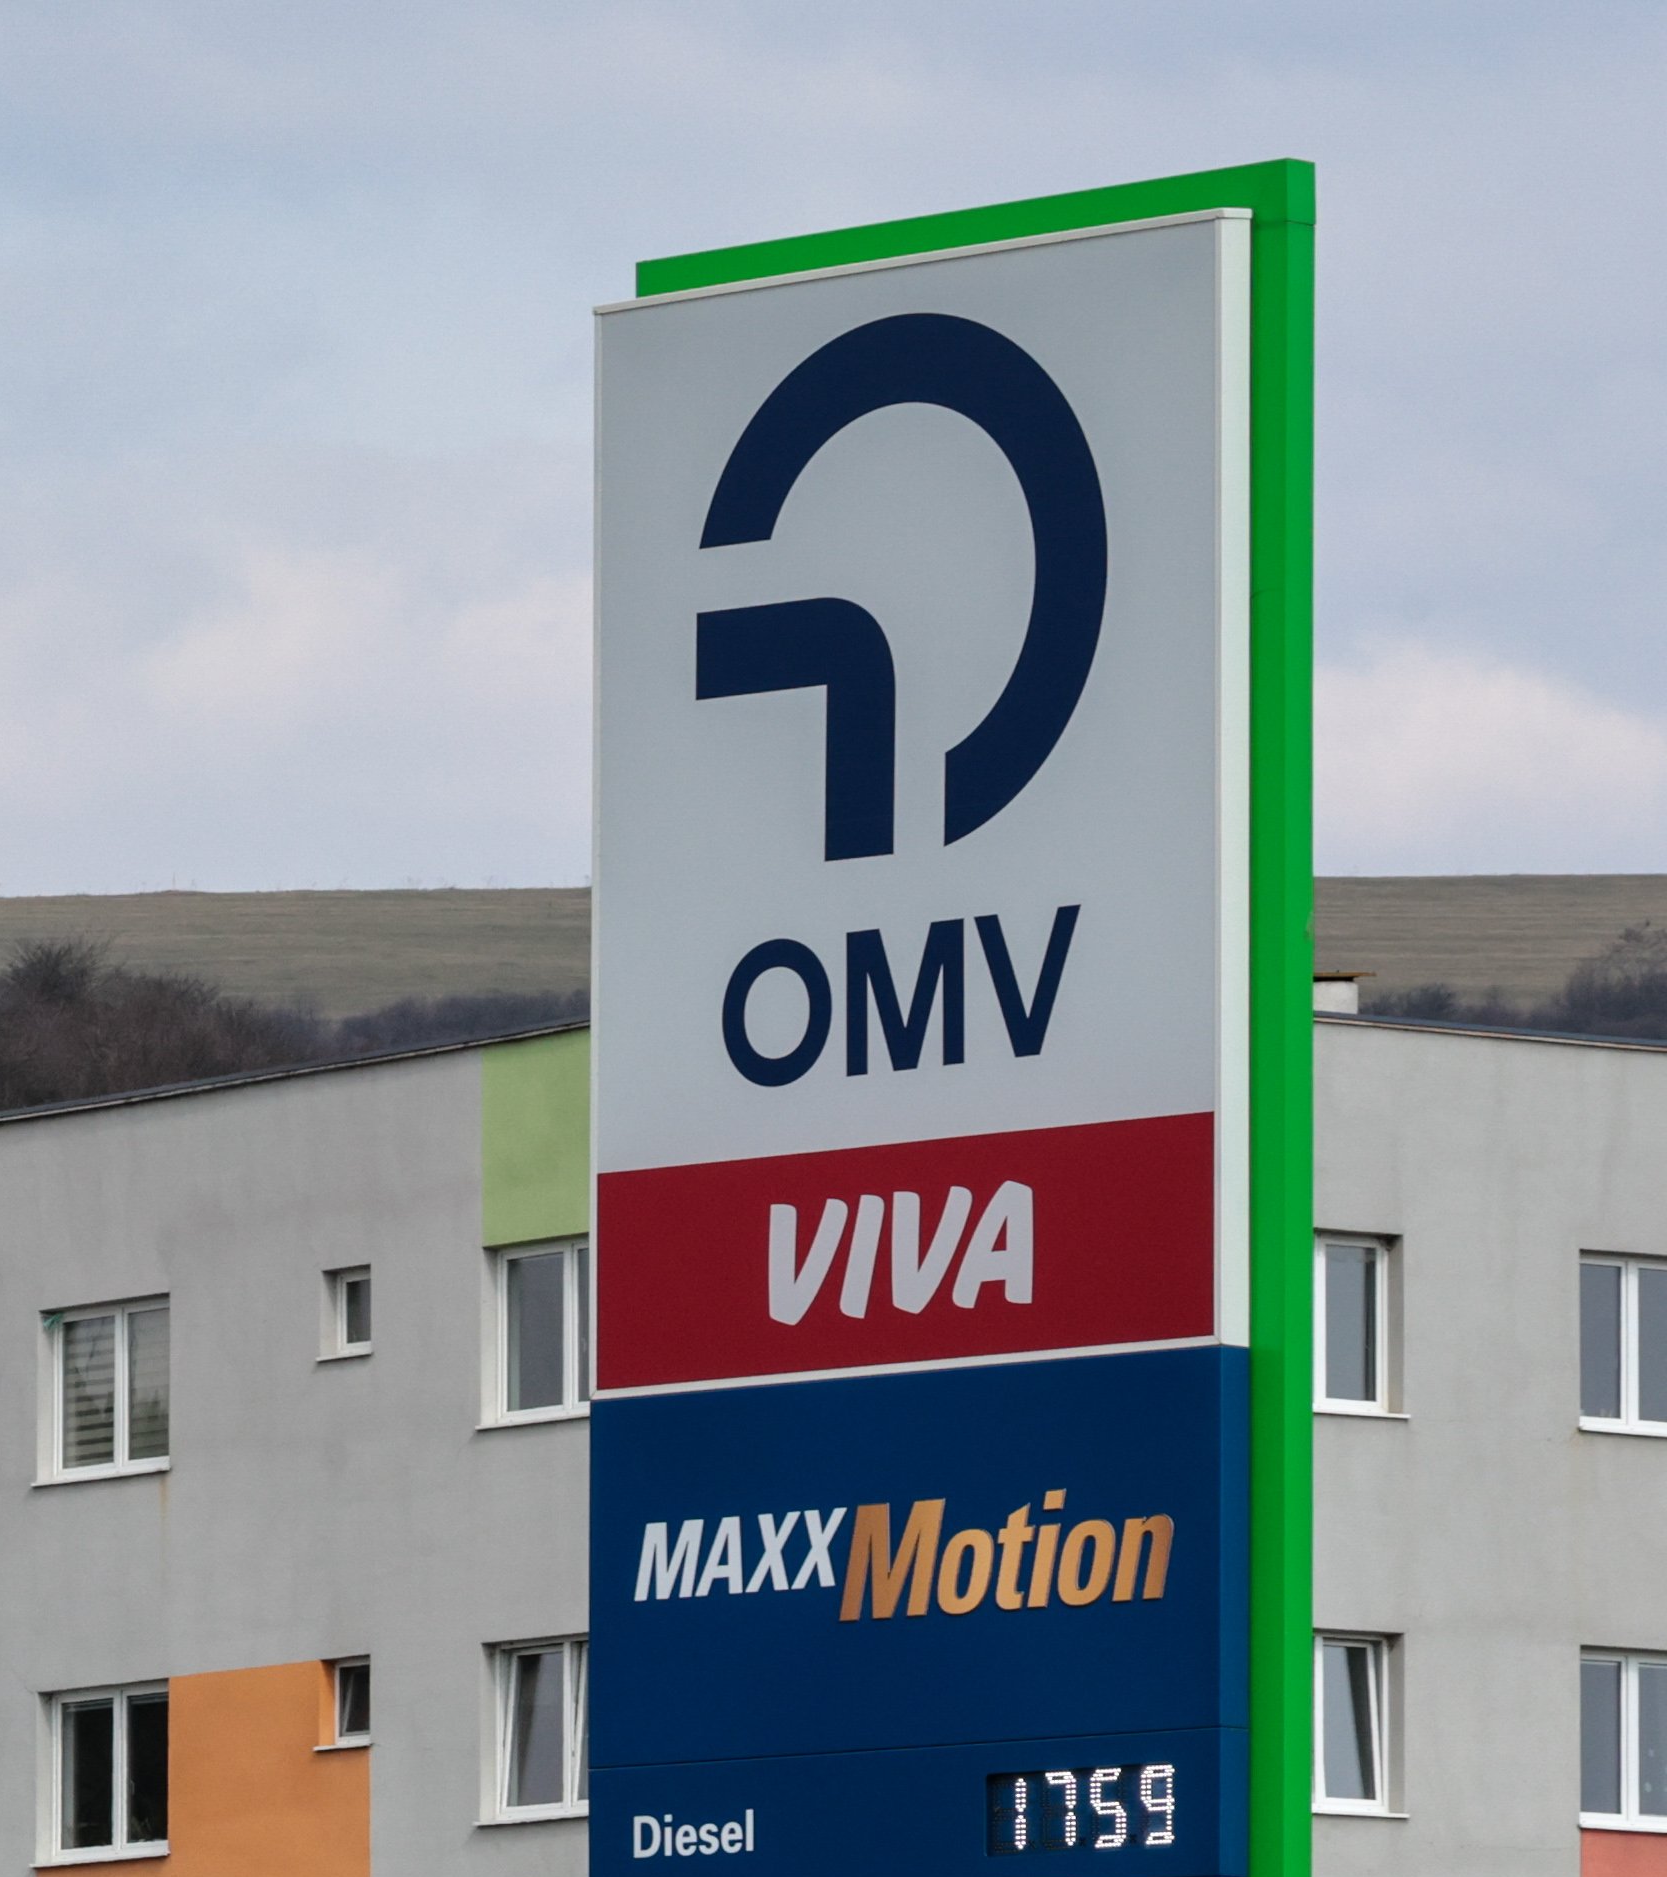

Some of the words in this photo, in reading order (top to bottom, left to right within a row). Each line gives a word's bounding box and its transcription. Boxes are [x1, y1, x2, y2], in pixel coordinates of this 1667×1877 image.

[721, 903, 1082, 1088] OMV
[768, 1180, 1035, 1327] VIVA
[632, 1809, 756, 1860] Diesel
[1013, 1763, 1176, 1850] 1759
